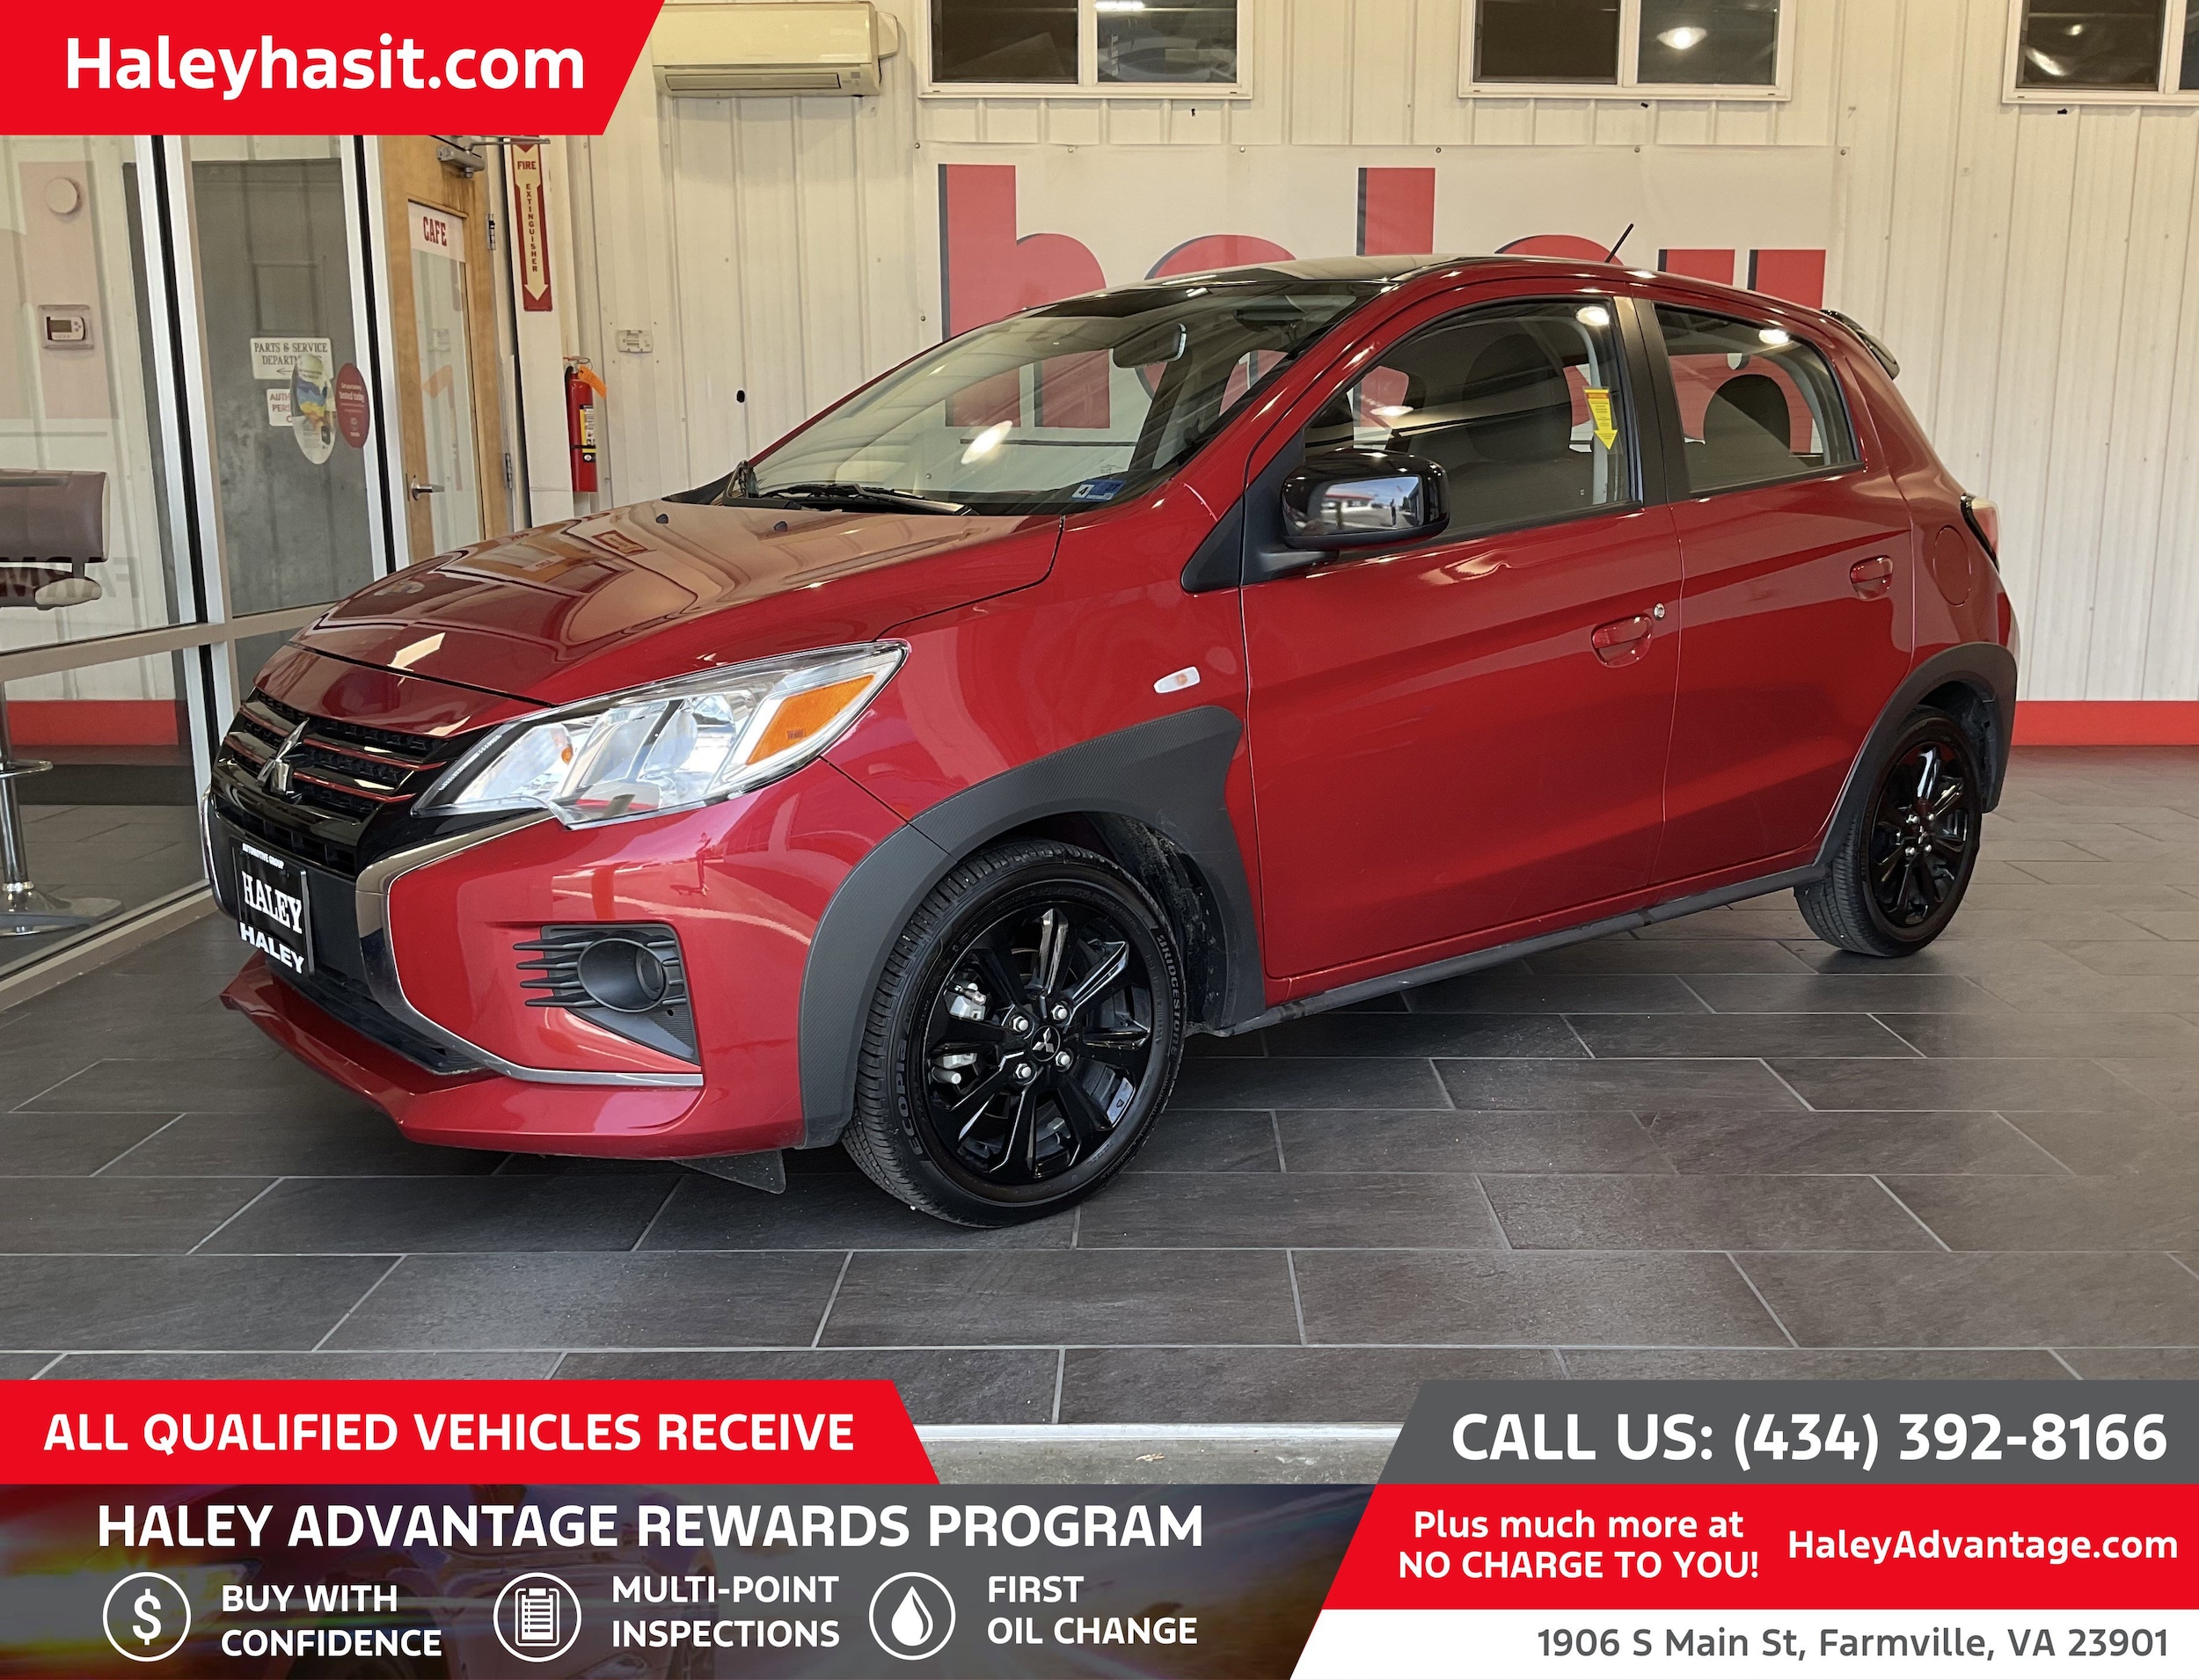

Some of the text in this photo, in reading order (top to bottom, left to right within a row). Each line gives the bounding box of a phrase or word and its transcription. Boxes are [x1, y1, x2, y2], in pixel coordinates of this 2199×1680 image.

[517, 161, 537, 170] FIRE
[423, 216, 447, 246] CAFE
[526, 184, 537, 272] EXTINGUISHER
[254, 343, 328, 353] PARTS & SERVICE
[242, 871, 303, 934] HALEY
[240, 922, 304, 974] HALEY
[896, 1039, 924, 1156] ECOPIA
